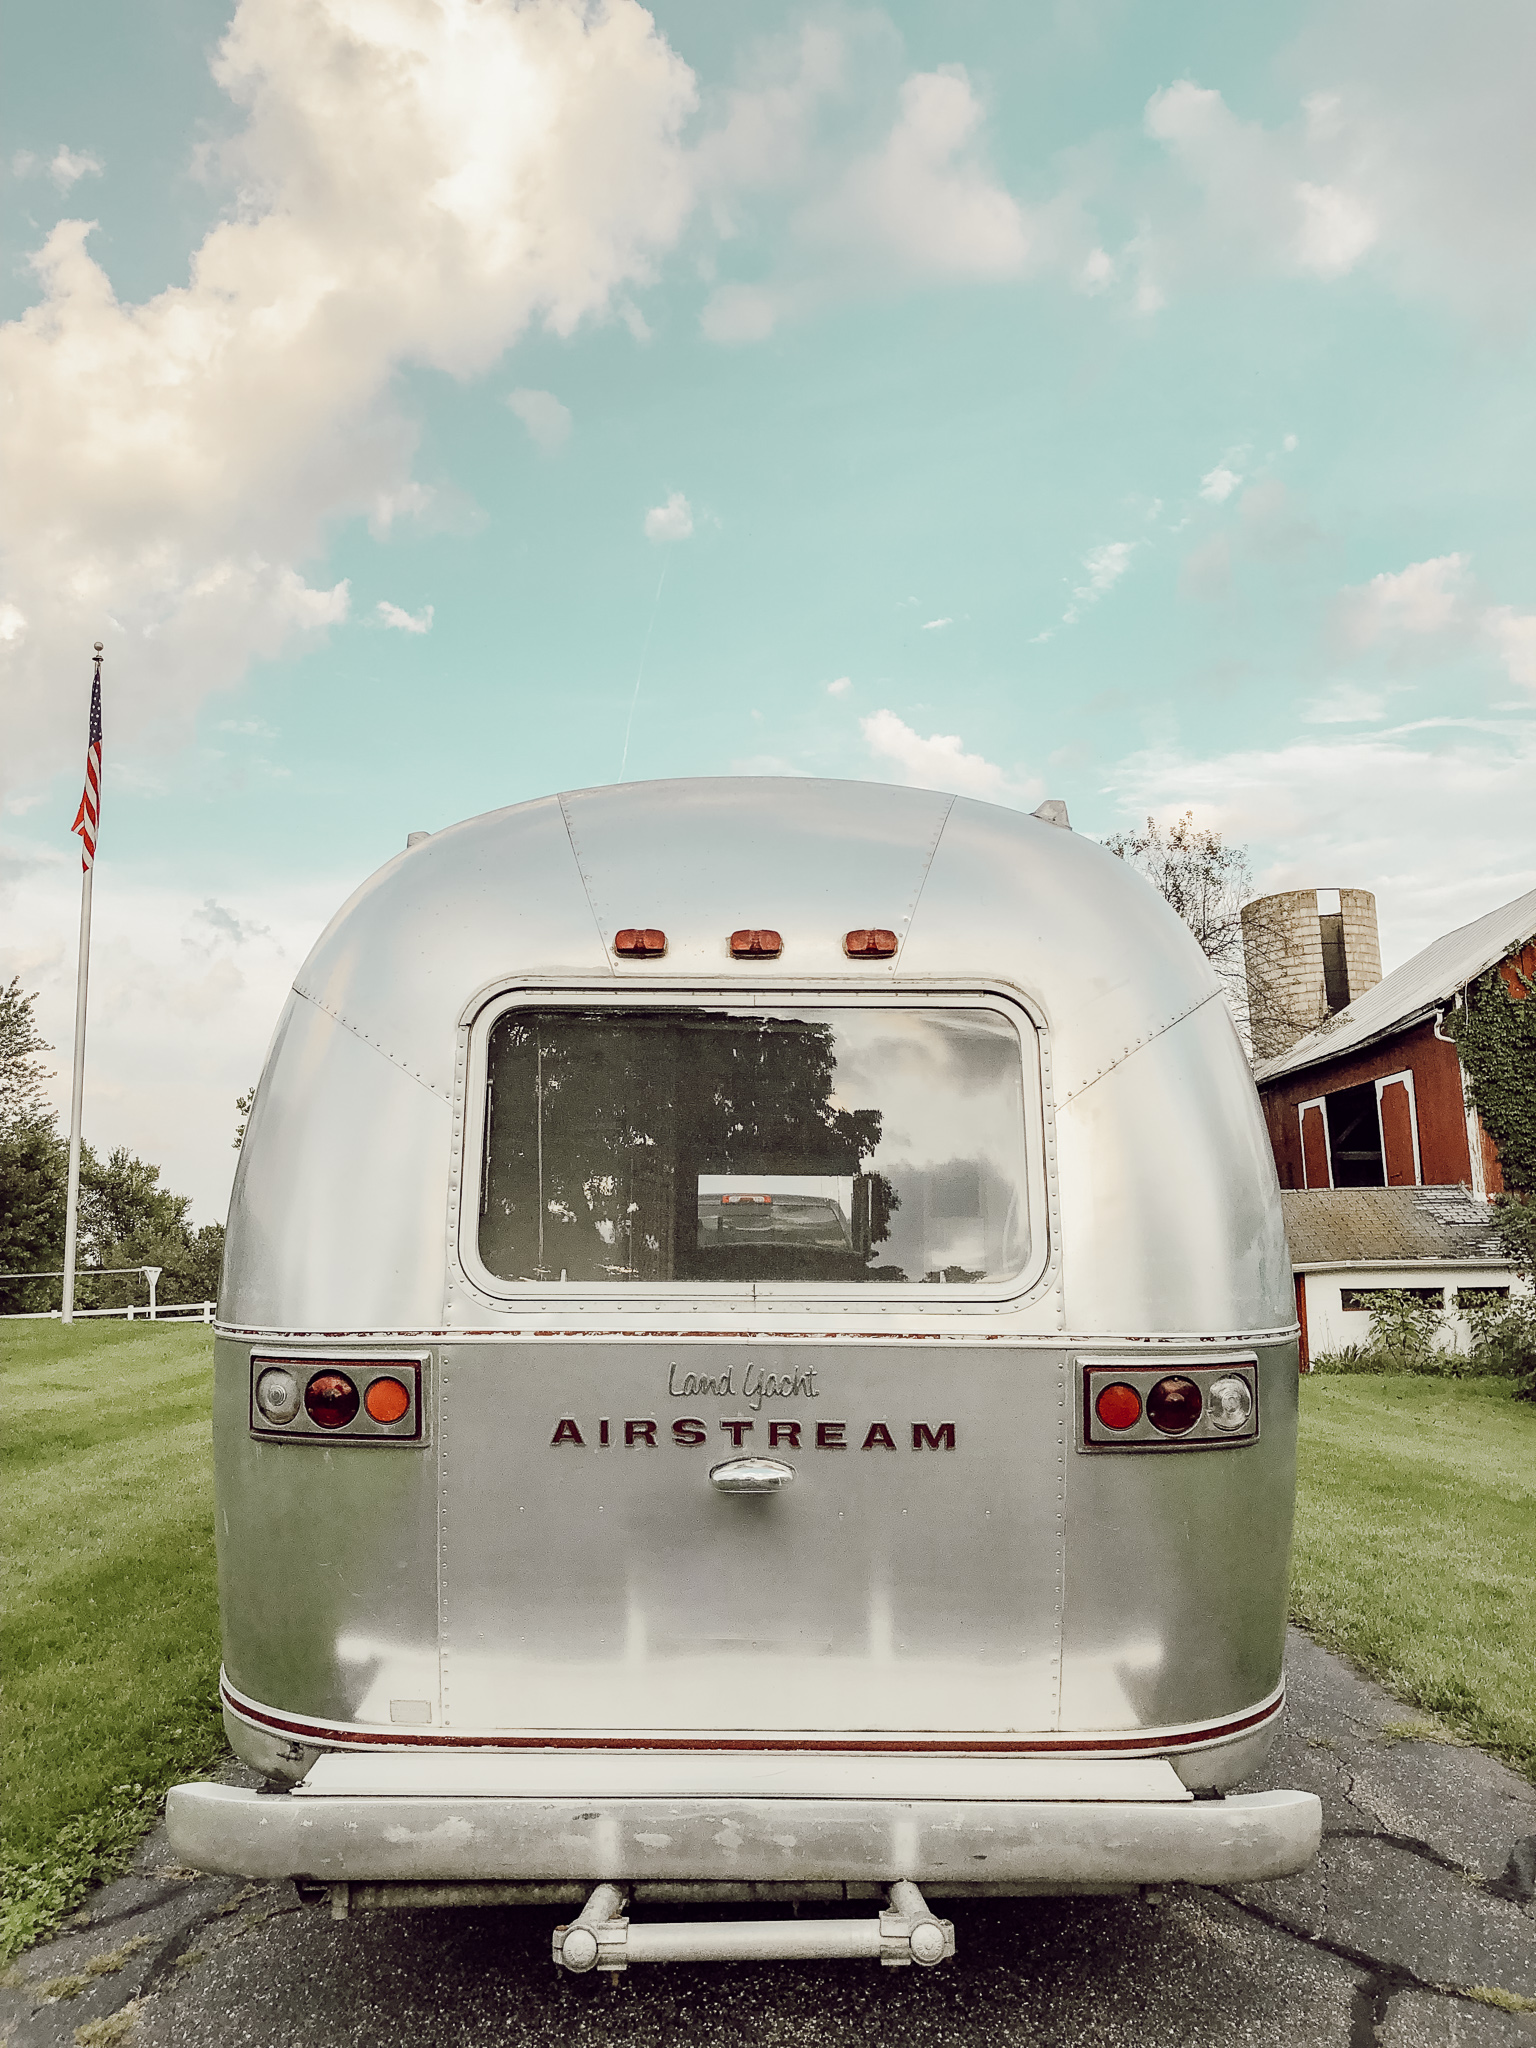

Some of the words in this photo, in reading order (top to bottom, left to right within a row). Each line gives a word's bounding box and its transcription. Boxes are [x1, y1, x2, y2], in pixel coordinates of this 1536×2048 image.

[668, 1361, 737, 1397] Land
[743, 1361, 820, 1411] Yacht
[549, 1415, 957, 1451] AIRSTREAM
